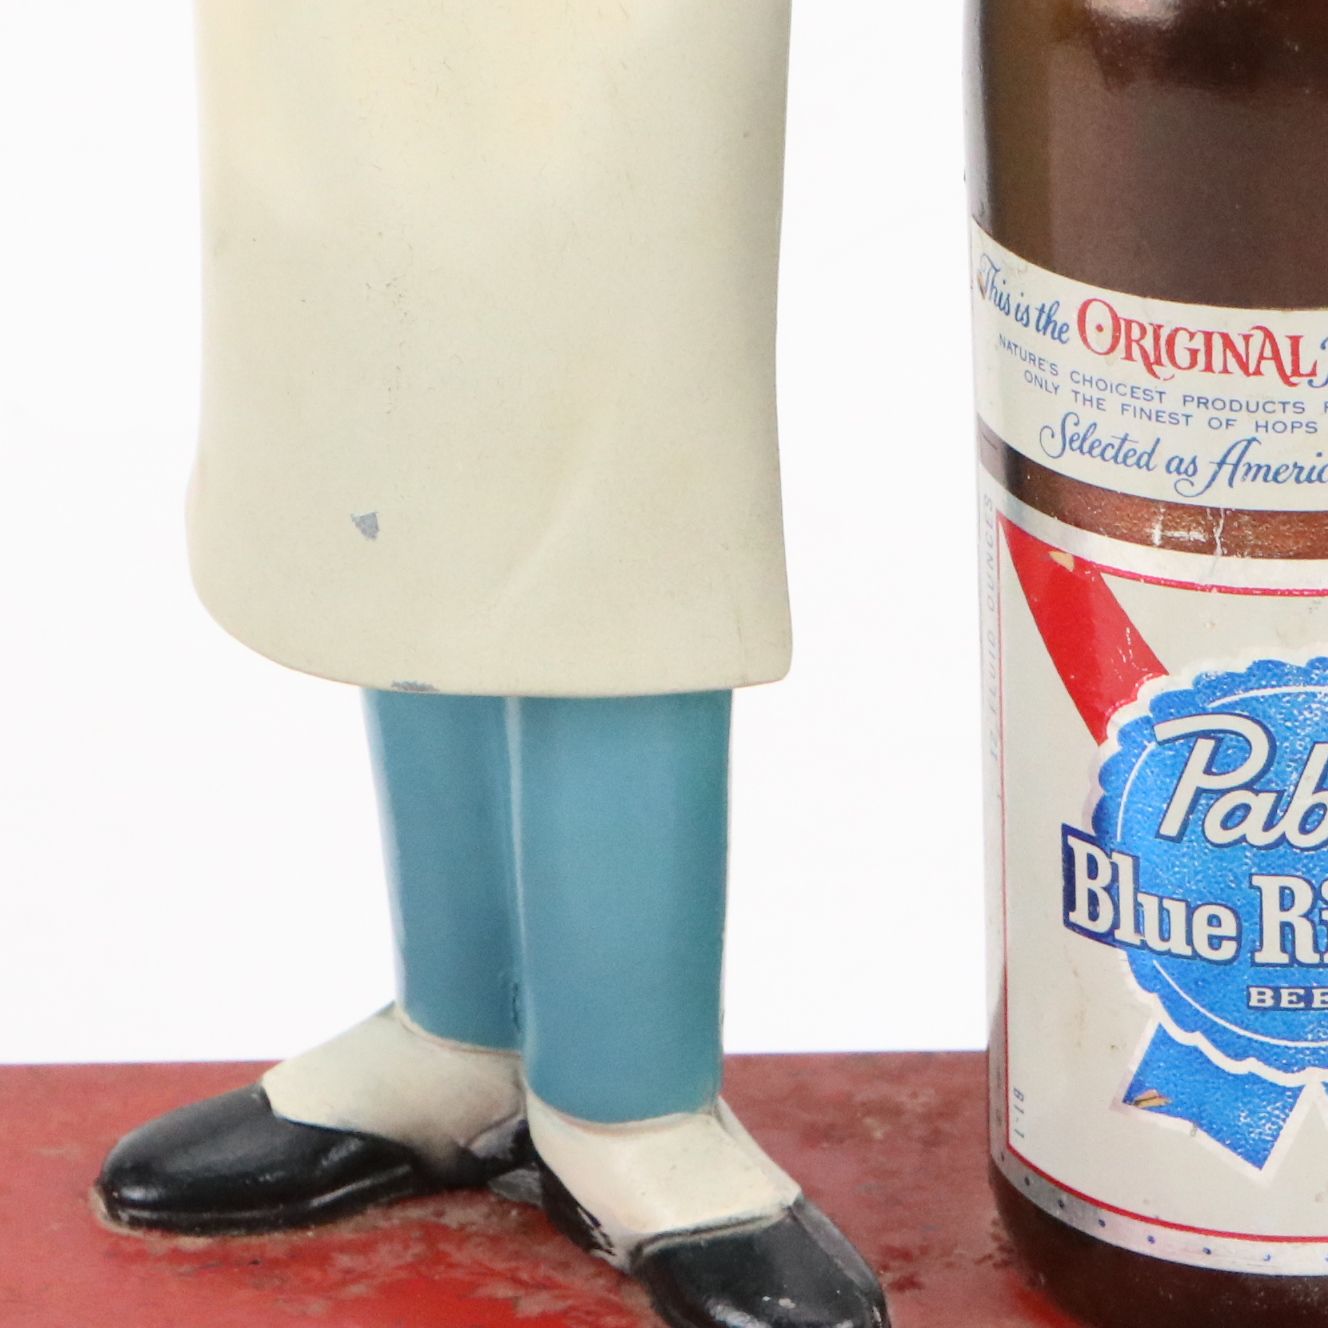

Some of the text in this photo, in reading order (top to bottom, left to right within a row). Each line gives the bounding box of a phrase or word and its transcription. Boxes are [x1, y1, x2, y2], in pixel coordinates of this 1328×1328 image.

[977, 251, 1011, 316] This
[1015, 292, 1031, 328] is
[1034, 300, 1070, 344] the
[999, 333, 1059, 377] NATURE'S
[1070, 372, 1167, 404] CHOICEST
[1183, 395, 1305, 414] PRODUCTS
[1024, 370, 1060, 396] ONLY
[1071, 390, 1106, 412] THE
[1121, 404, 1192, 426] FINEST
[1208, 417, 1237, 430] OF
[1255, 420, 1318, 434] HOPS
[1040, 411, 1157, 472] Selected
[1166, 452, 1198, 477] as
[983, 493, 995, 613] OUNCES
[987, 629, 998, 715] FLUID
[1066, 835, 1242, 963] Blue
